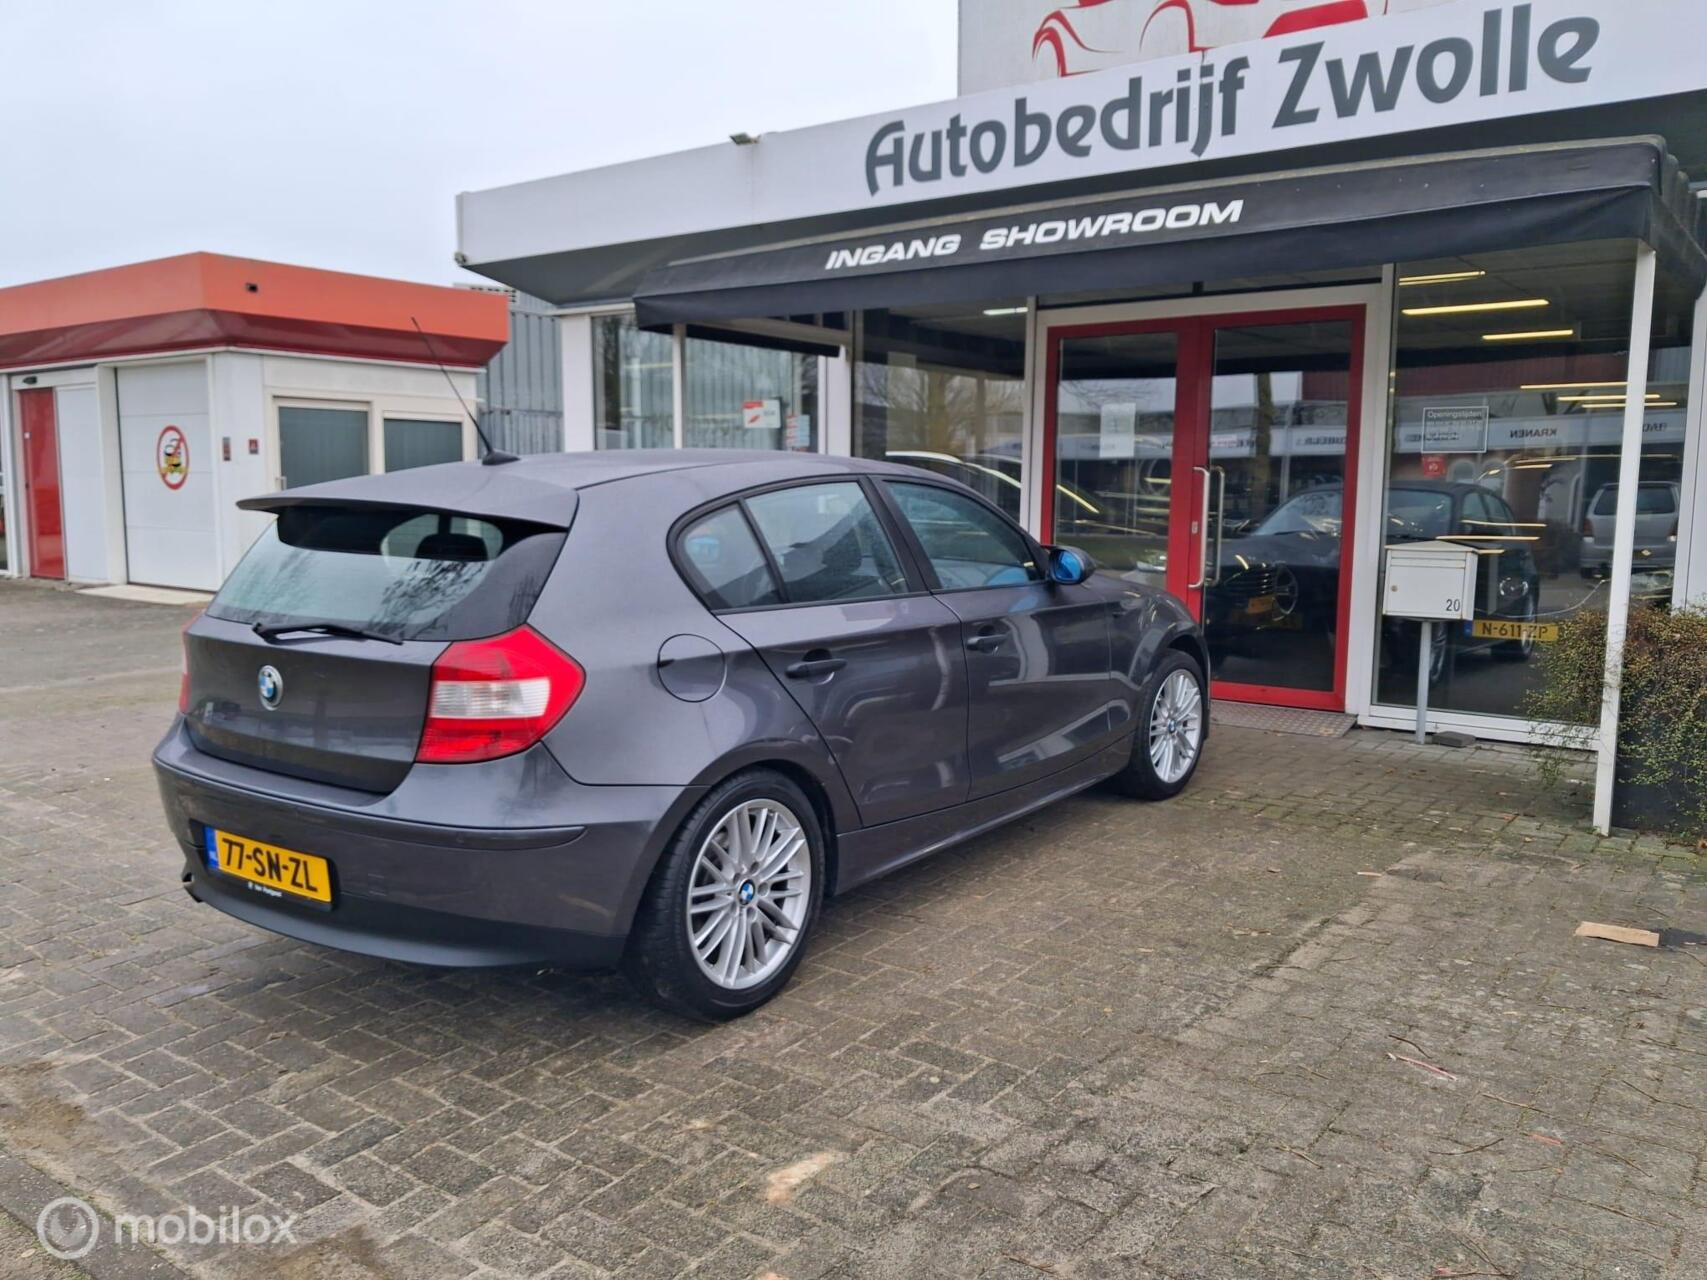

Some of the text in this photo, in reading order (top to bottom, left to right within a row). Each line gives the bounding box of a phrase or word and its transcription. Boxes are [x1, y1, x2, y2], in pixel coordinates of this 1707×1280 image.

[865, 3, 1600, 197] Autobedrijf Zwolle
[825, 200, 1243, 269] INGANG SHOWROOM
[1446, 599, 1460, 611] 20
[222, 837, 318, 893] 77-SN-ZL
